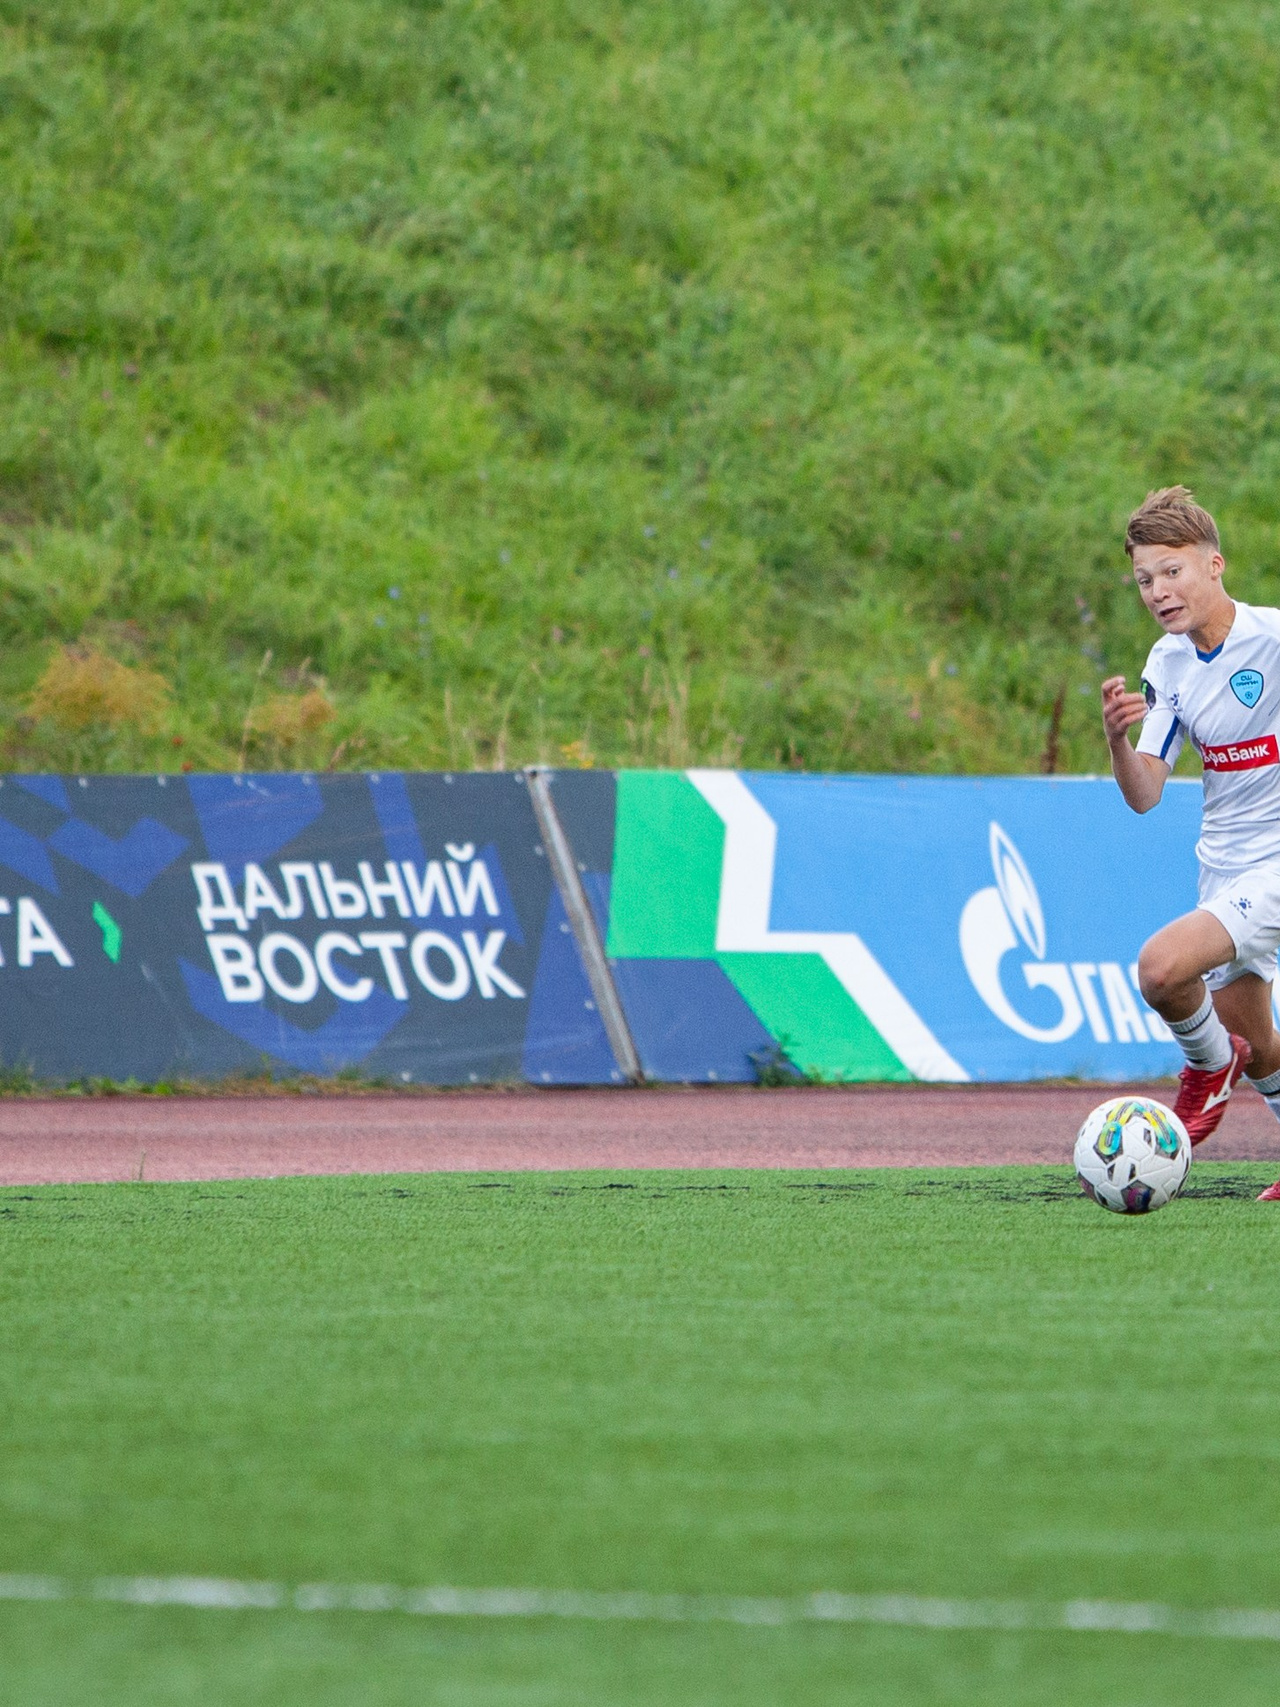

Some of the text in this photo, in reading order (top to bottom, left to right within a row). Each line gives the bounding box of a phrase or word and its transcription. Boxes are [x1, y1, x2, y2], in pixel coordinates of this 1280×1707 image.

[1226, 743, 1270, 763] Банк
[190, 842, 500, 931] ДАЛЬНИЙ
[206, 931, 526, 1002] ВОСТОК
